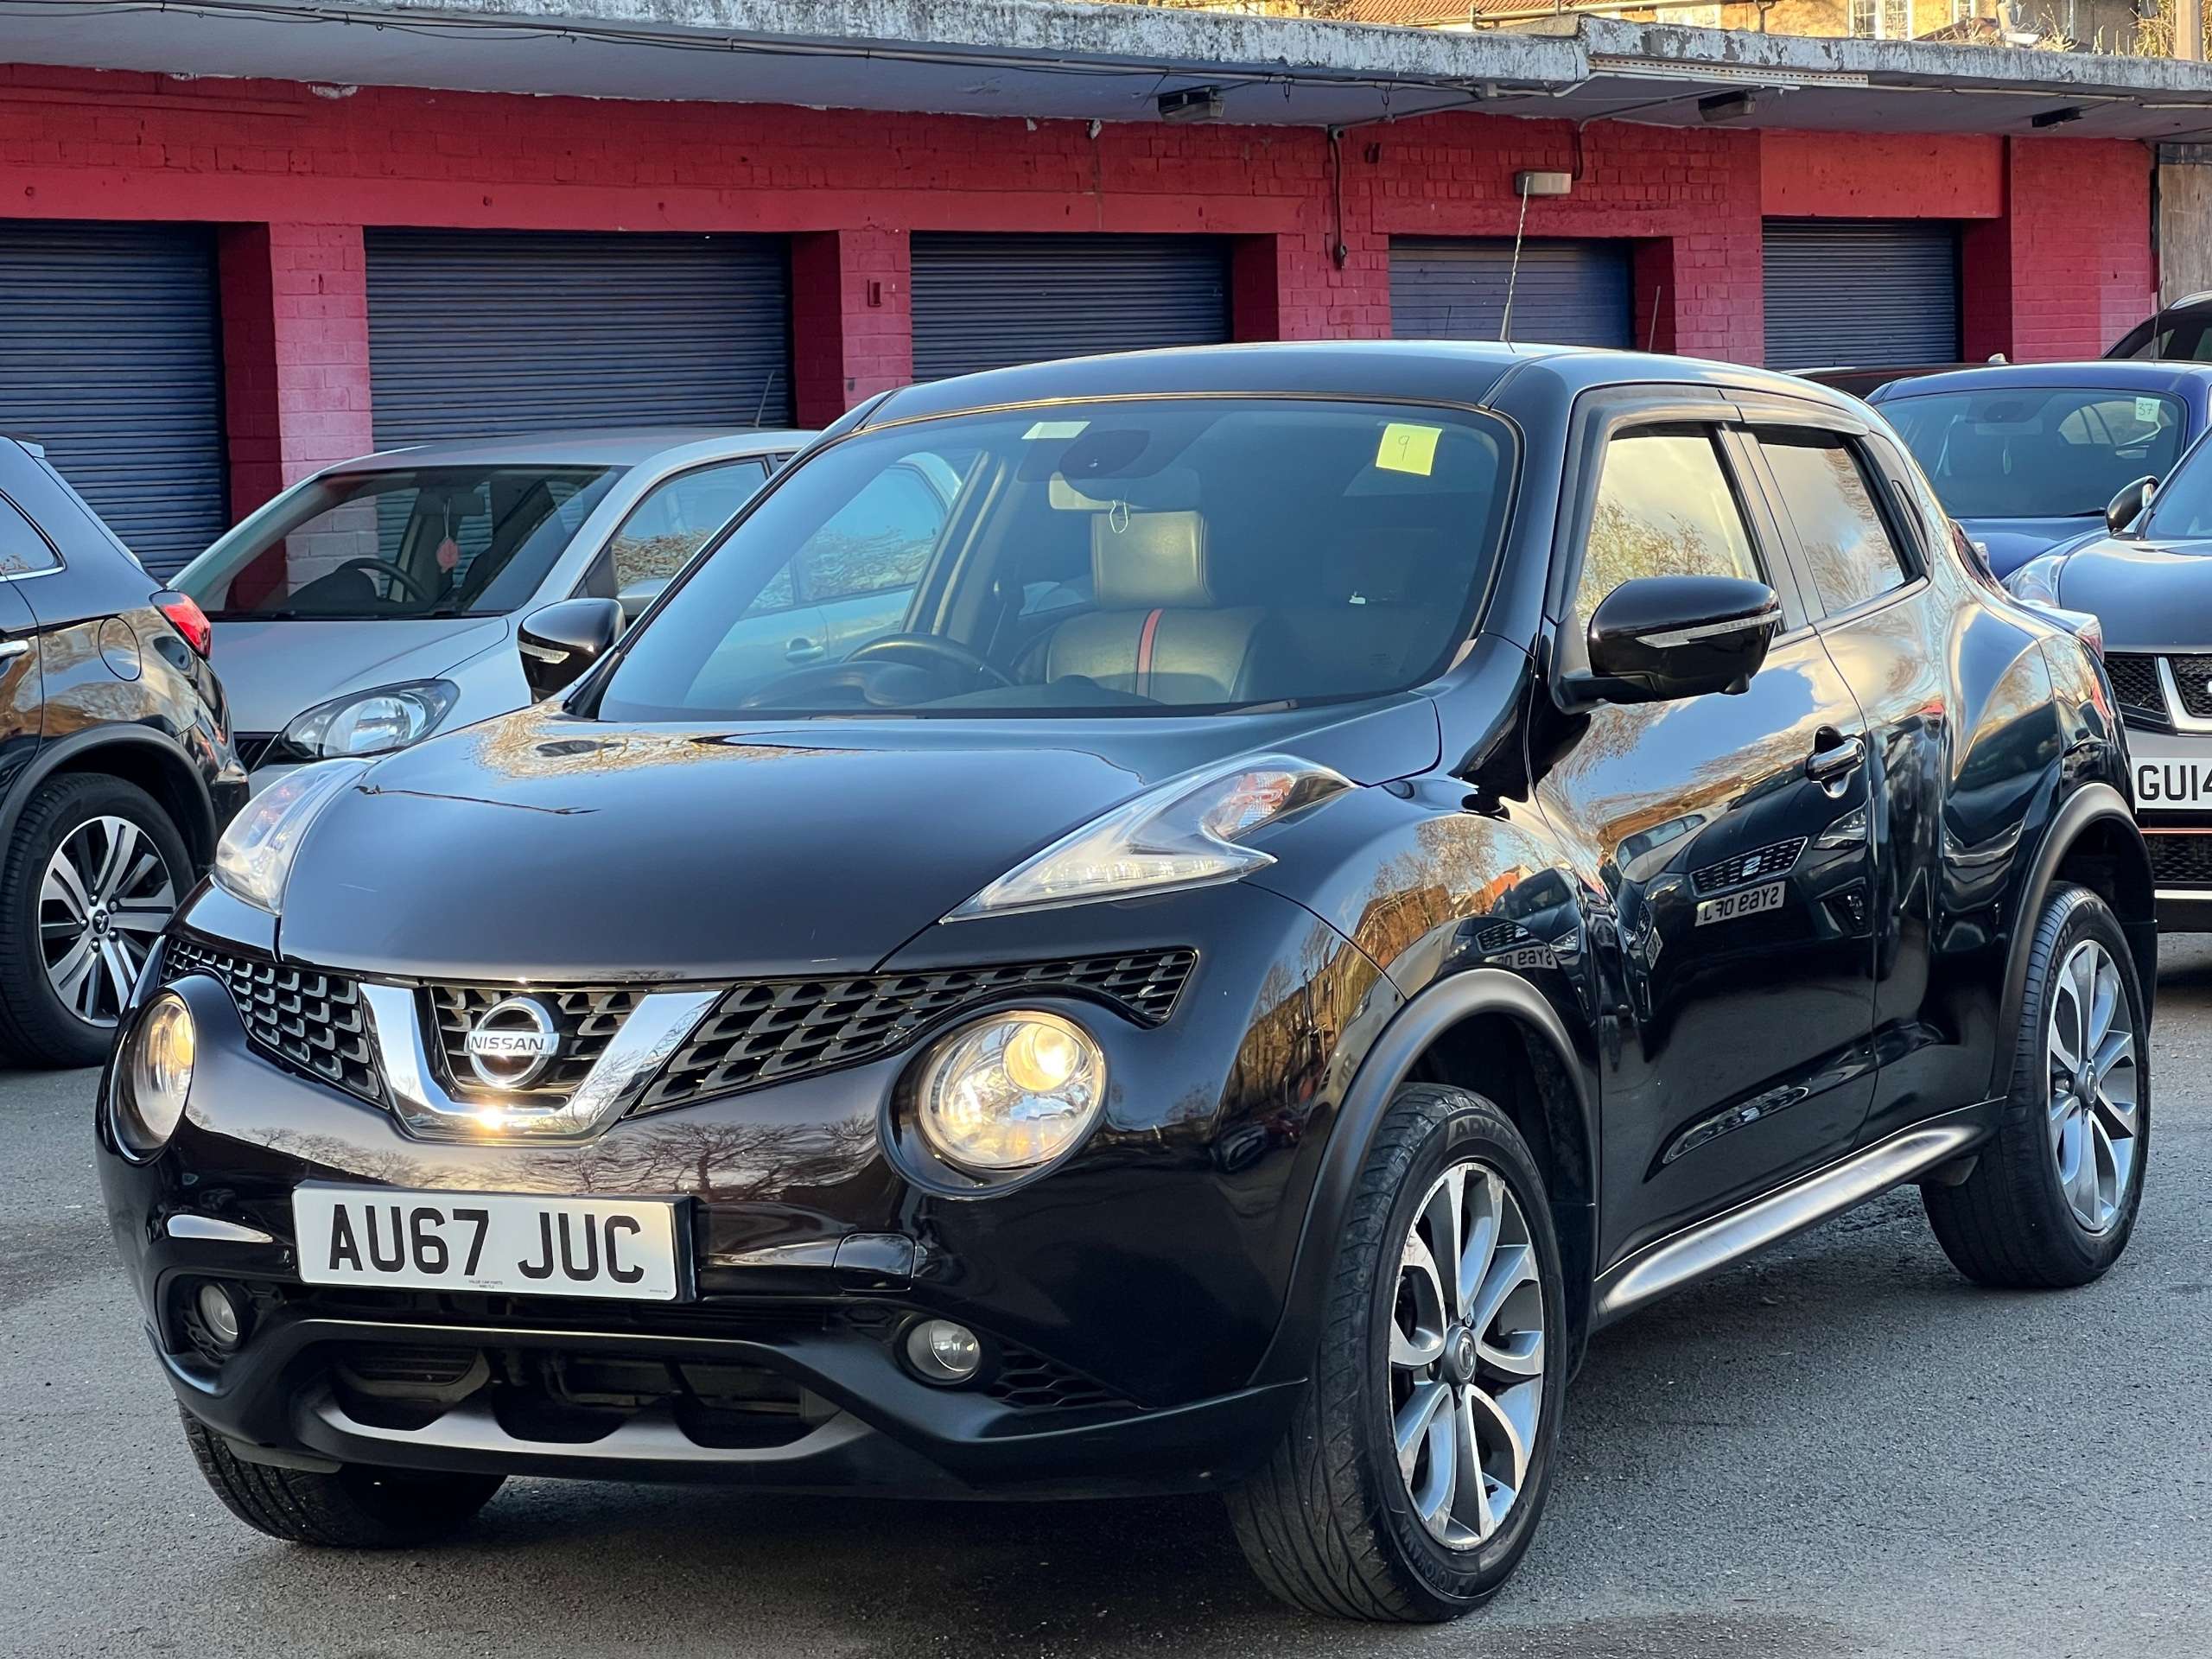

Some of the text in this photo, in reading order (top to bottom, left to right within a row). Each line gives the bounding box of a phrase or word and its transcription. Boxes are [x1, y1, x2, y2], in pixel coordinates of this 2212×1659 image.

[2138, 403, 2152, 416] 37
[1398, 435, 1410, 461] 9
[471, 1036, 544, 1052] NISSAN
[328, 1204, 645, 1284] AU67 JUC
